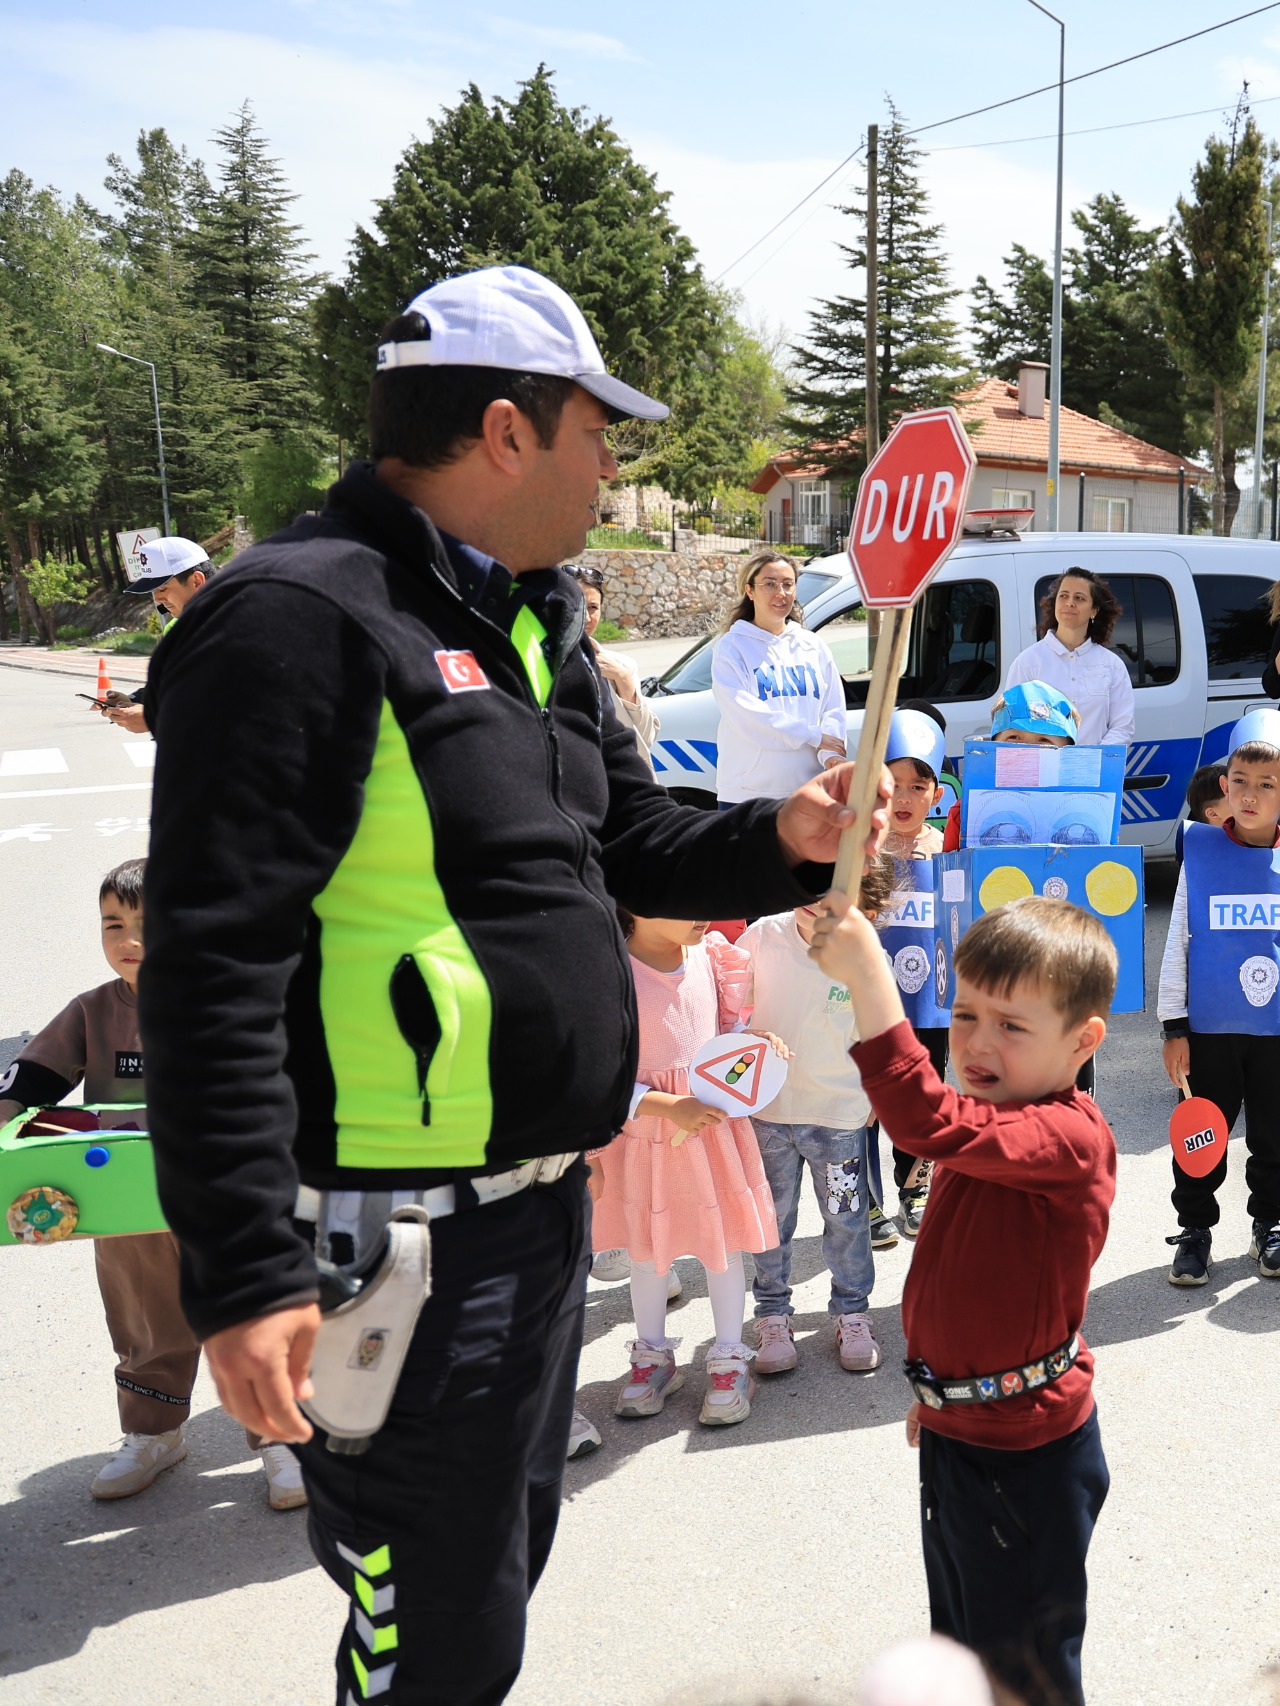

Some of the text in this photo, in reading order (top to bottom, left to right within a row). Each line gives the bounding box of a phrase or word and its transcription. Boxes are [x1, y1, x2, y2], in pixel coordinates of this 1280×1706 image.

[859, 471, 955, 546] DUR
[1185, 1129, 1214, 1152] DUR
[134, 1385, 154, 1396] SINCE
[943, 1386, 972, 1396] SONIC
